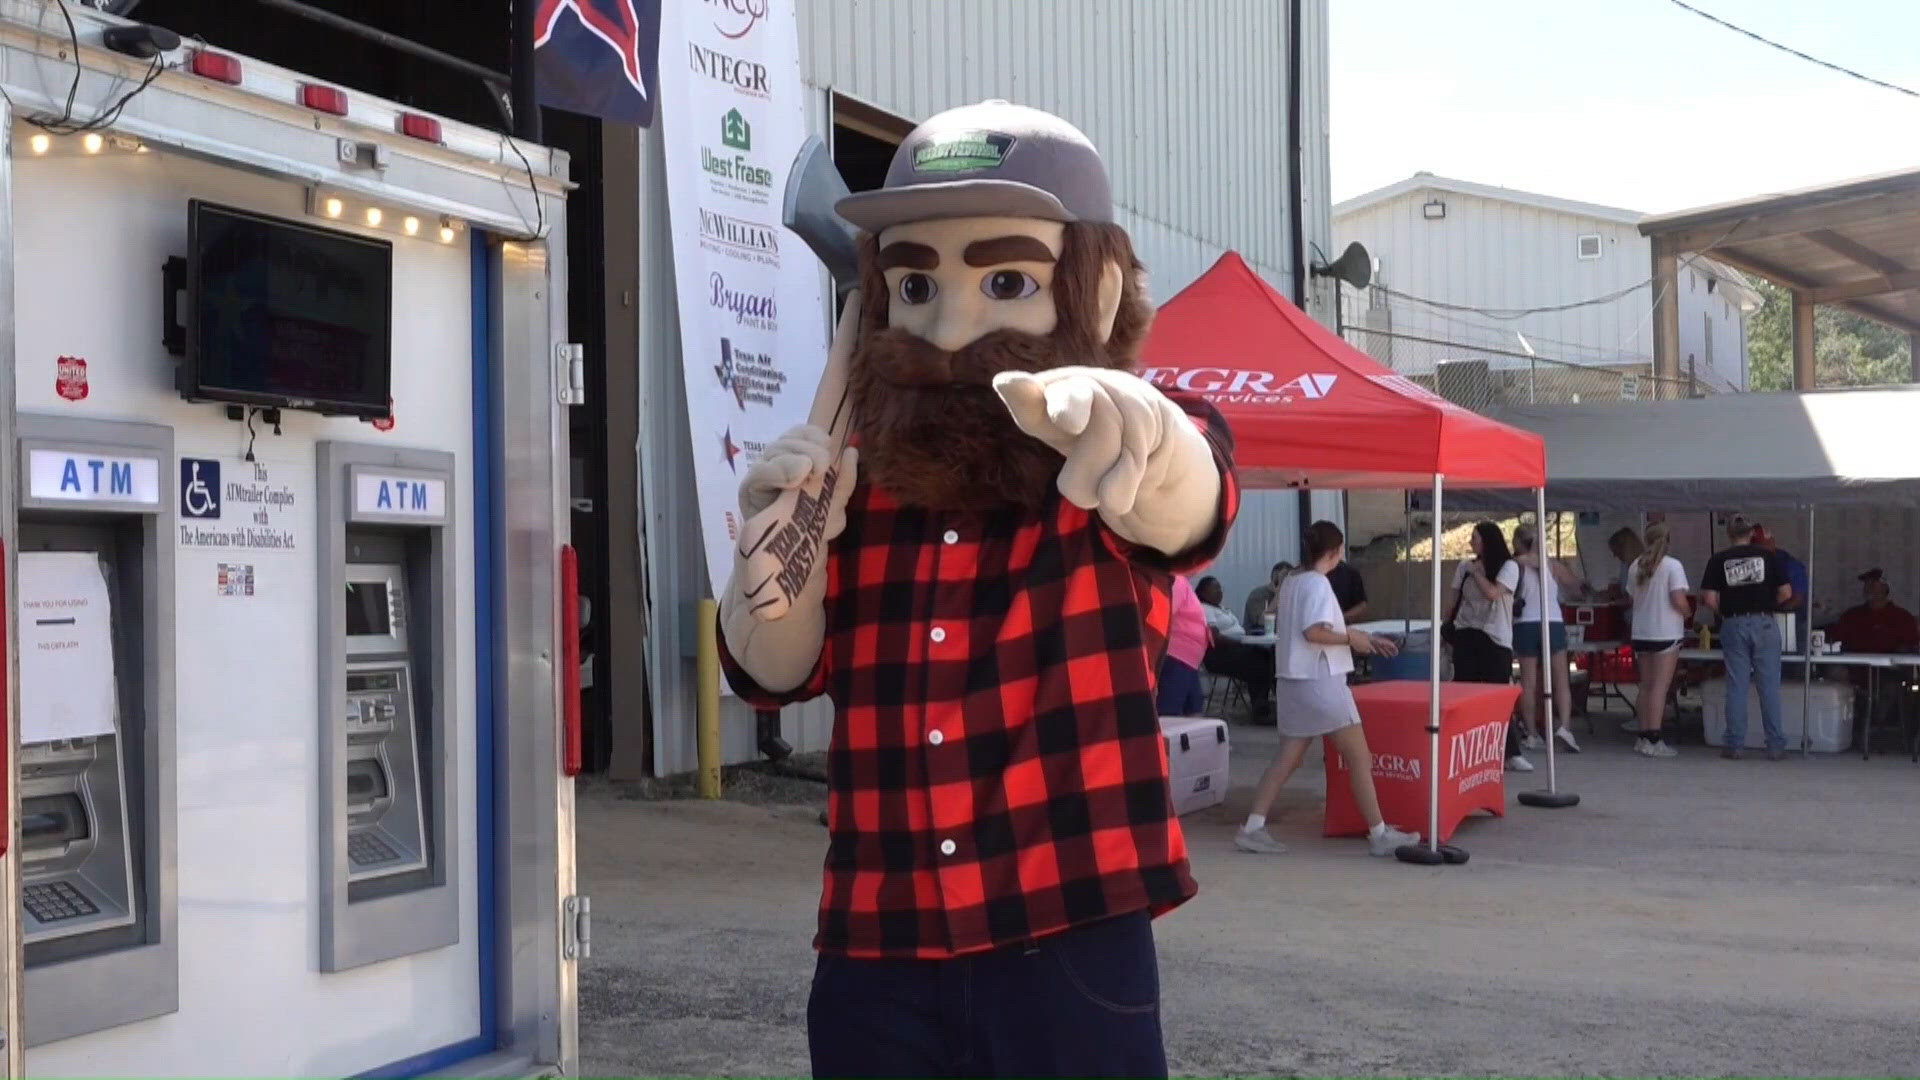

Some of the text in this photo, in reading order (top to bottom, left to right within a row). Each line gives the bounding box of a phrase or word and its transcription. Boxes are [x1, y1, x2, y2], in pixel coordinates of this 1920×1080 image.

[689, 41, 771, 93] INTEGR
[701, 146, 732, 179] West
[758, 354, 771, 366] Air
[1141, 366, 1338, 398] EGRA
[1201, 393, 1294, 404] ervices
[60, 458, 132, 495] ATM
[253, 463, 268, 482] This
[263, 485, 295, 512] Complies
[377, 480, 427, 511] ATM
[253, 506, 269, 525] with
[180, 525, 193, 546] The
[195, 525, 230, 547] Americans
[231, 527, 245, 548] with
[247, 528, 282, 549] Disabilities
[1338, 753, 1420, 778] IEGRA
